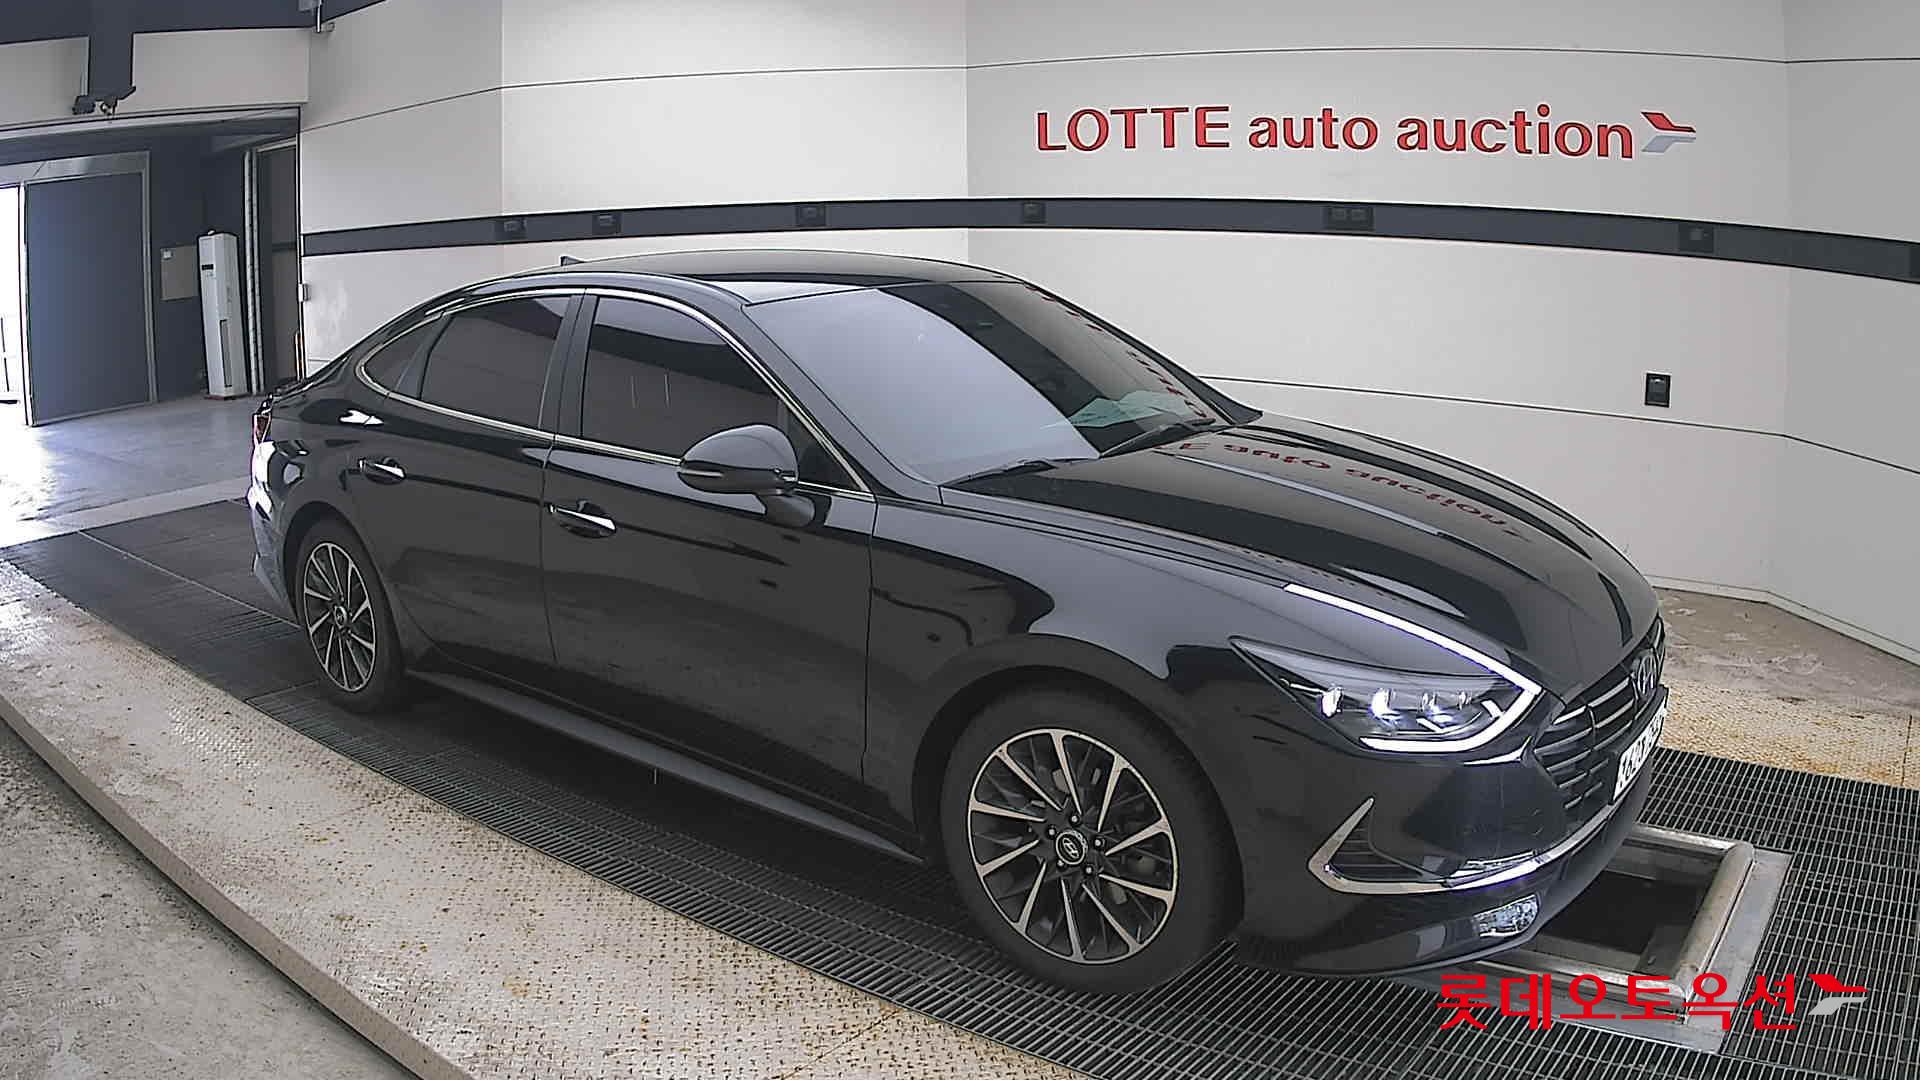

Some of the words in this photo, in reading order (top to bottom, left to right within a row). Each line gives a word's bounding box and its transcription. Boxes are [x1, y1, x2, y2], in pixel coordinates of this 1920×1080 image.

[1036, 106, 1230, 151] LOTTE
[1248, 108, 1378, 151] auto
[1396, 104, 1634, 158] auction
